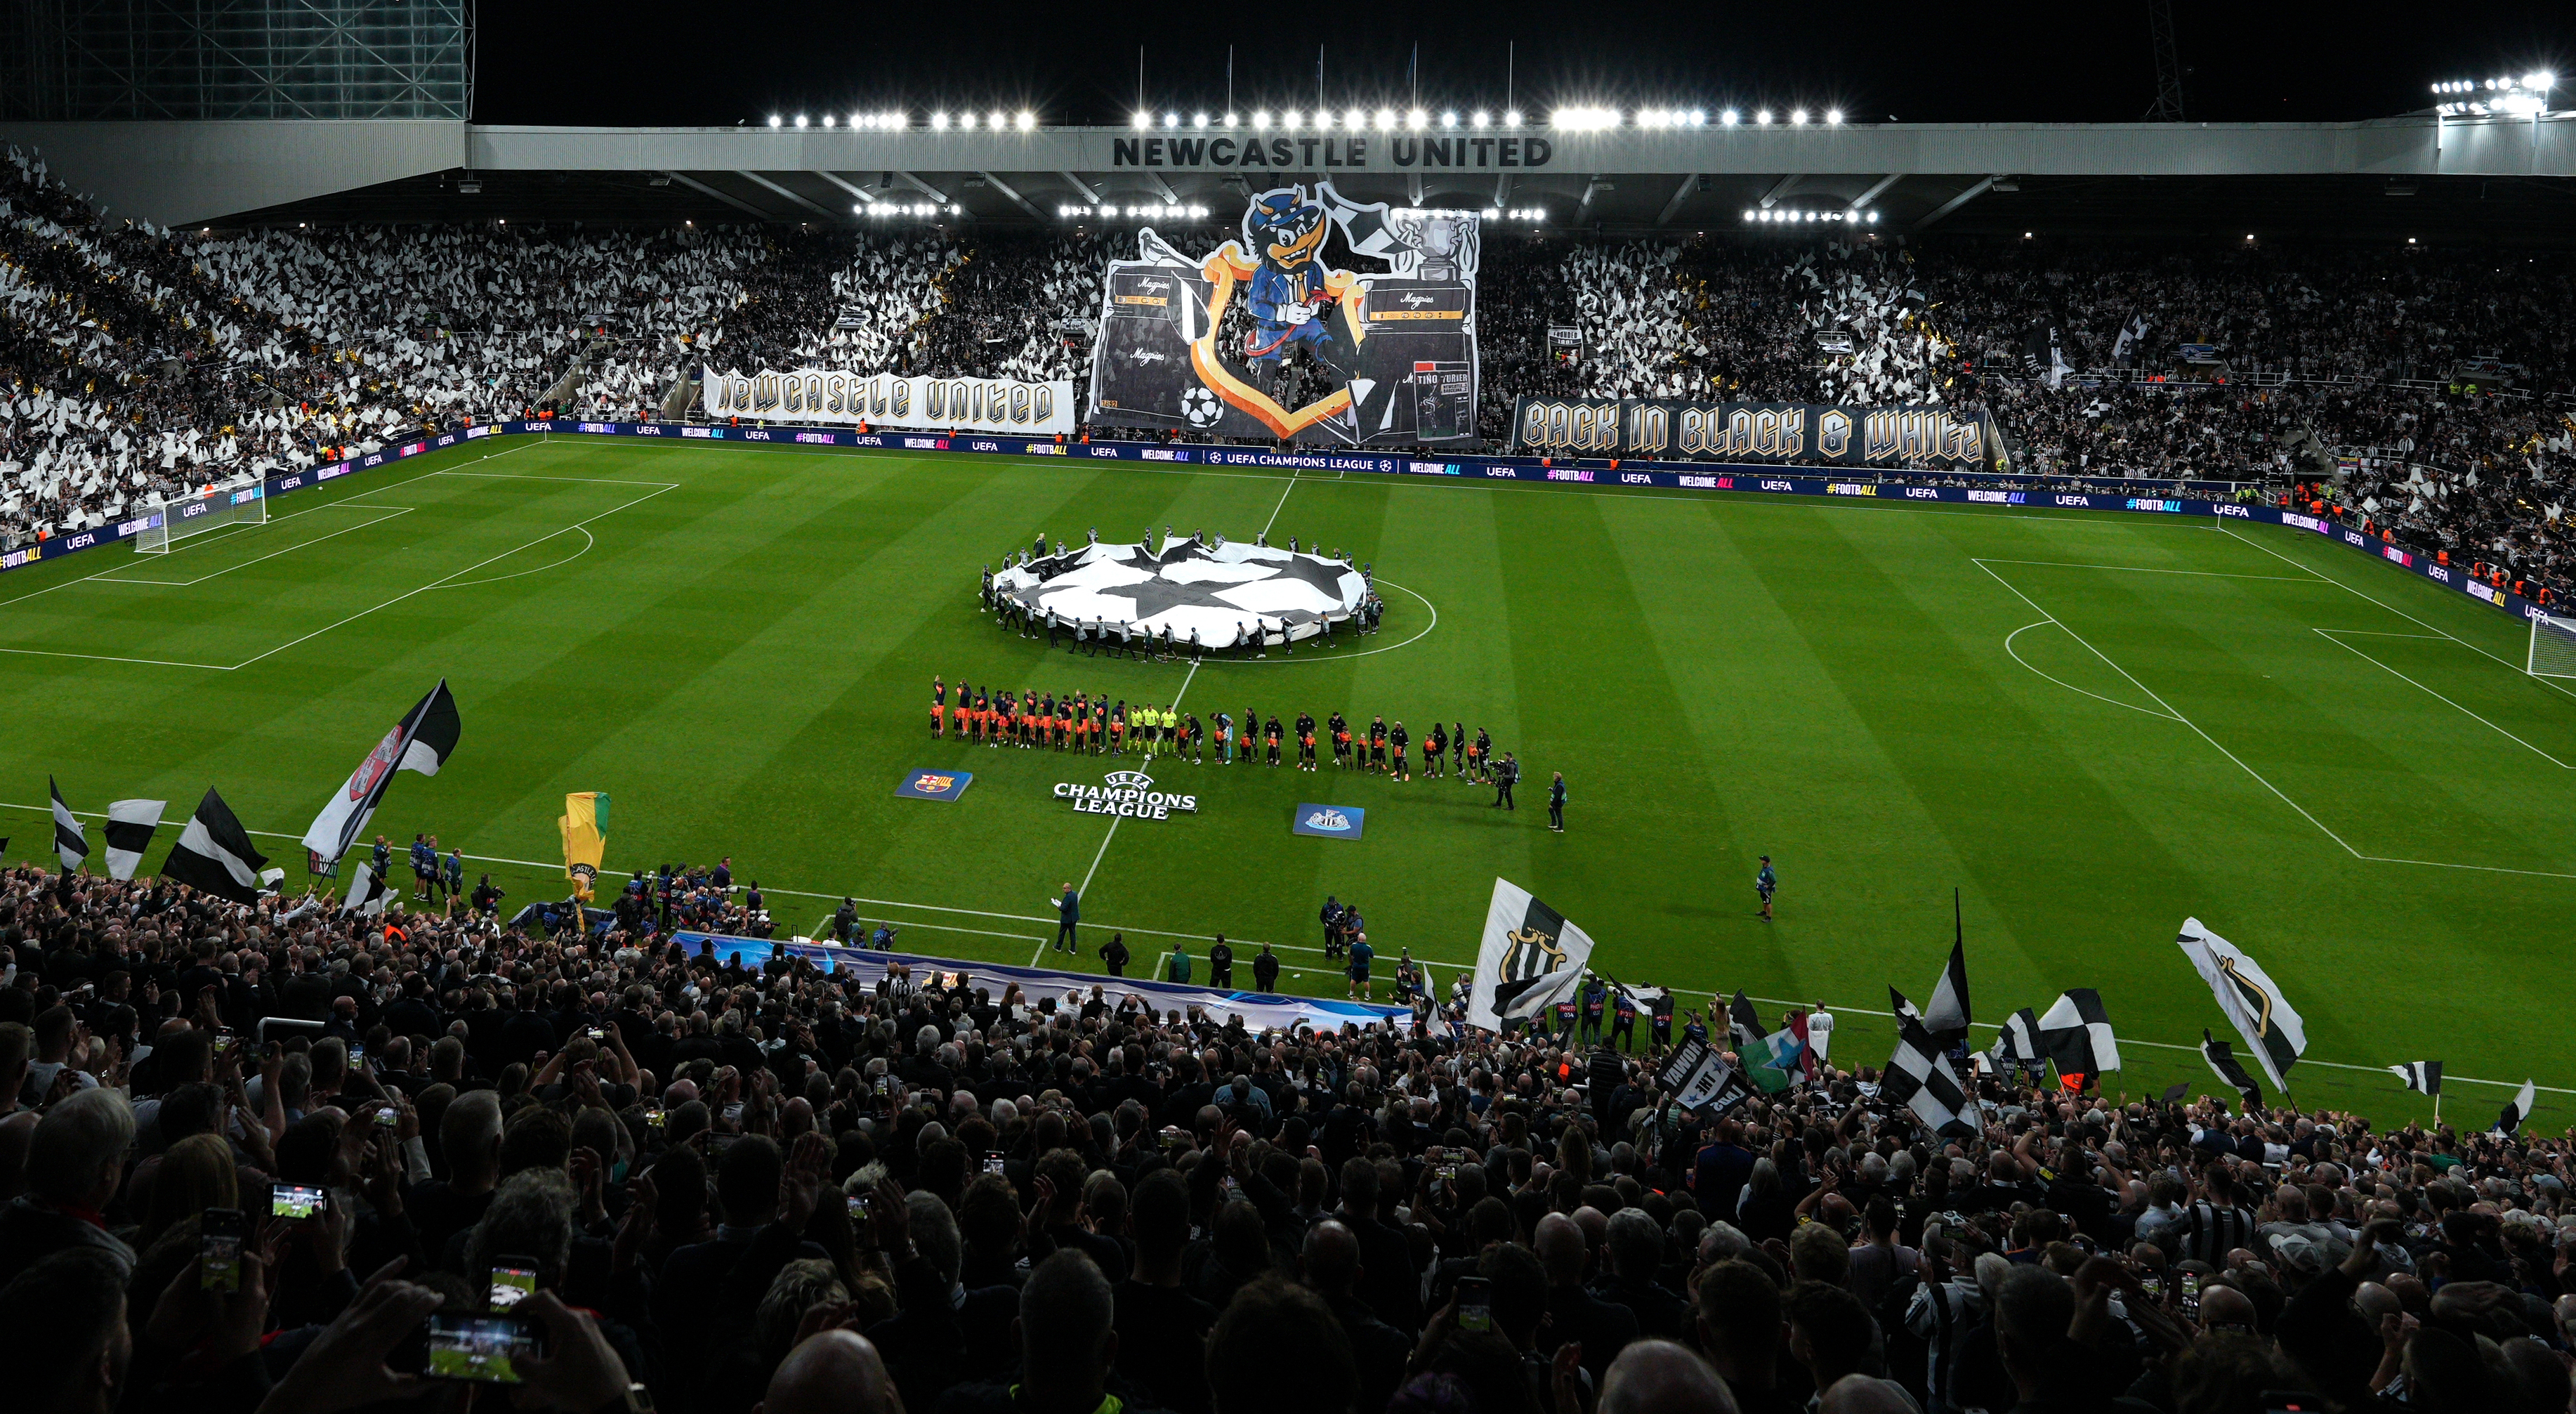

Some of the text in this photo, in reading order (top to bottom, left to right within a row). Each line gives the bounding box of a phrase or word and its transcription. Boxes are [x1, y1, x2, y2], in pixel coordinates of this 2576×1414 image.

[1114, 138, 1552, 167] NEWCASTLE UNITED
[1138, 277, 1170, 294] Magpies
[1400, 292, 1434, 310] Magpies
[1130, 347, 1165, 367] Magpies
[467, 424, 502, 438] WELCOME ALL
[578, 423, 615, 433] #FOOTBALL
[637, 426, 660, 435] UEFA
[682, 427, 723, 438] WELCOME ALL
[1818, 408, 1852, 459] &
[438, 435, 454, 445] UEFA
[746, 431, 770, 440] UEFA
[796, 433, 834, 444] #FOOTBALL
[857, 436, 882, 446] UEFA
[400, 442, 426, 457] #FOOTBALL
[905, 438, 949, 449] WELCOME ALL
[972, 441, 998, 452] UEFA
[1026, 443, 1067, 455] #FOOTBALL
[1091, 447, 1117, 457] UEFA
[1141, 449, 1189, 461] WELCOME ALL
[364, 454, 382, 466] UEFA
[1228, 454, 1374, 470] UEFA CHAMPIONS LEAGUE
[317, 462, 350, 480] WELCOME ALL
[1409, 462, 1460, 475] WELCOME ALL
[1487, 467, 1516, 477] UEFA
[1547, 469, 1594, 482] #FOOTBALL
[281, 476, 301, 490] UEFA
[1621, 473, 1652, 484] UEFA
[1679, 475, 1733, 488] WELCOME ALL
[1761, 480, 1792, 491] UEFA
[230, 486, 263, 506] #FOOTBALL
[1826, 483, 1877, 496] #FOOTBALL
[1906, 487, 1938, 499] UEFA
[1968, 490, 2025, 504] WELCOME ALL
[2056, 495, 2089, 506] UEFA
[183, 502, 206, 517] UEFA
[2126, 498, 2181, 512] #FOOTBALL
[2214, 504, 2249, 517] UEFA
[118, 512, 162, 537] WELCOME ALL
[2282, 511, 2328, 534] WELCOME ALL
[67, 533, 95, 549] UEFA
[2345, 530, 2364, 547] UEFA
[2383, 545, 2412, 568] #FOOTBALL
[2429, 564, 2448, 582] UEFA
[2466, 579, 2506, 607] WELCOME ALL
[1105, 773, 1150, 790] UEFA
[1053, 783, 1196, 809] CHAMPIONS
[1073, 798, 1169, 820] LEAGUE
